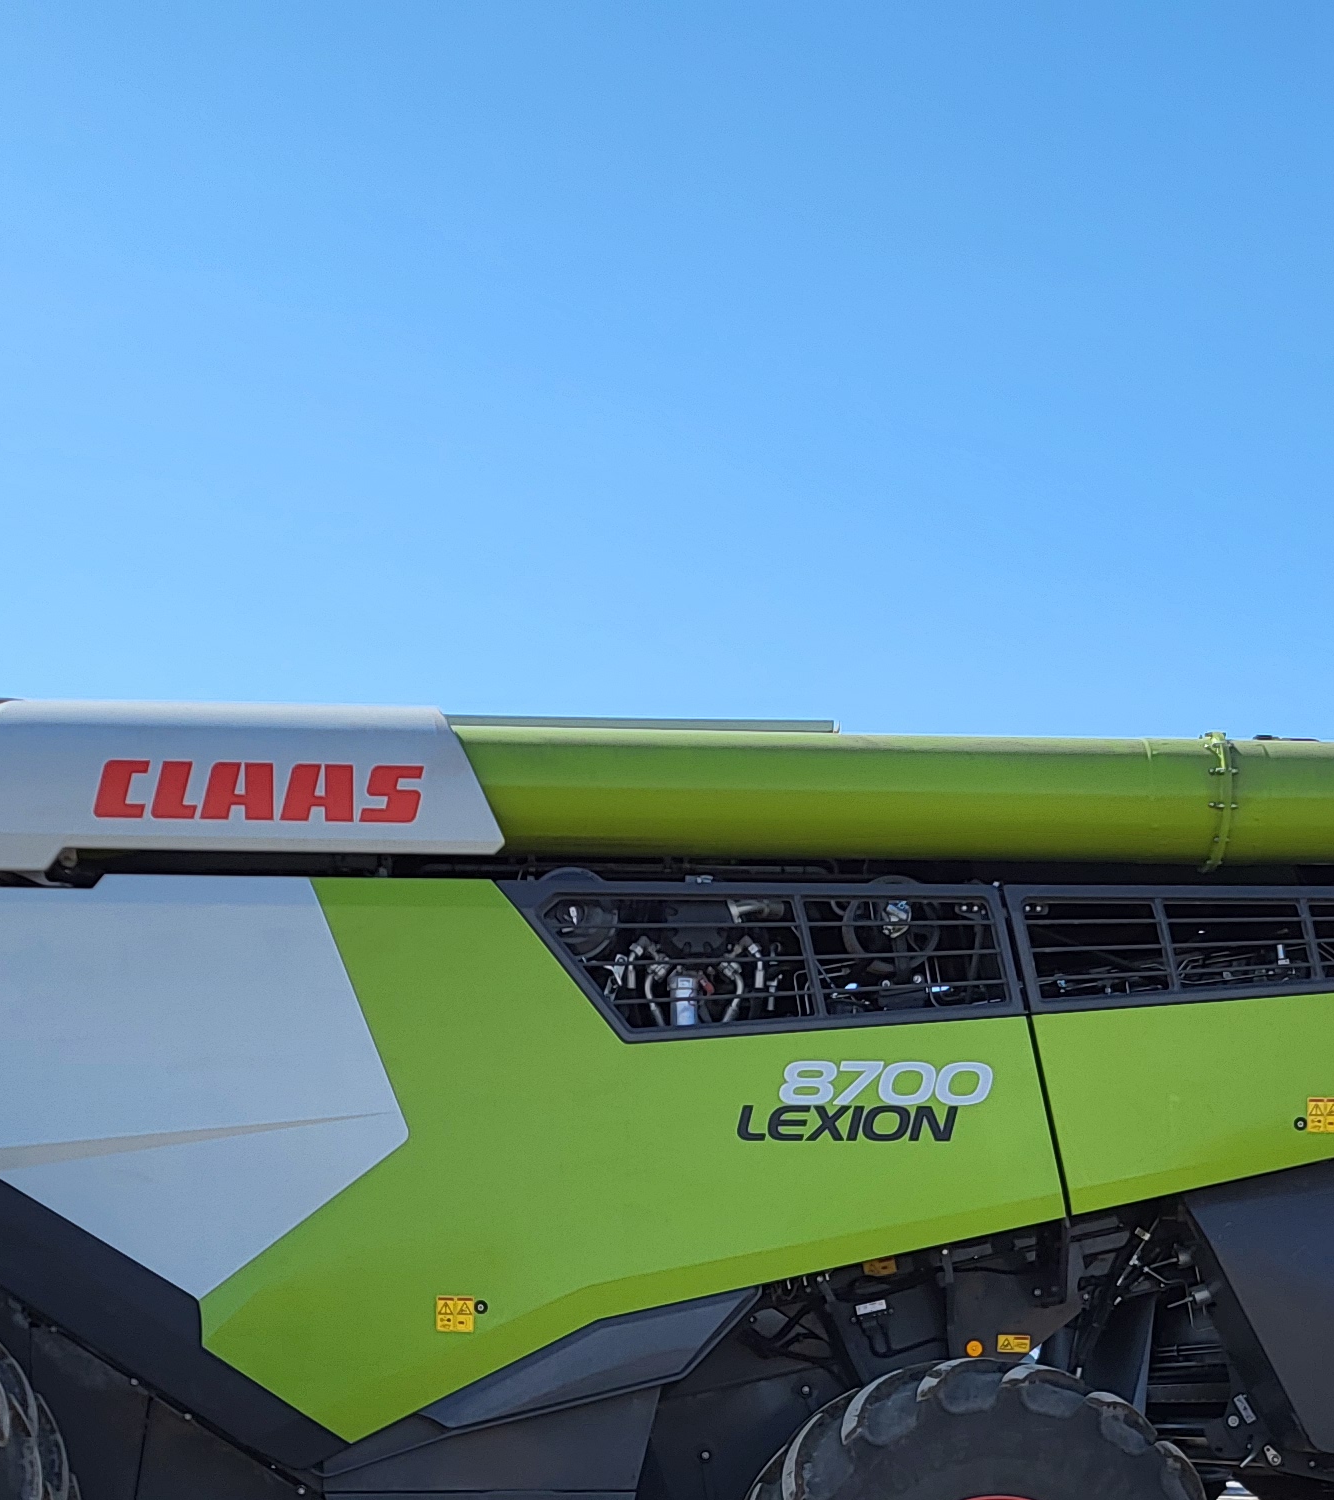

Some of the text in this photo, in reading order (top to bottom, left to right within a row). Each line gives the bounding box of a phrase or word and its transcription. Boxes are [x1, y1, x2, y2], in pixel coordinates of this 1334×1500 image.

[93, 759, 424, 824] CLAAS
[779, 1060, 994, 1106] 8700
[736, 1105, 959, 1142] LEXION
